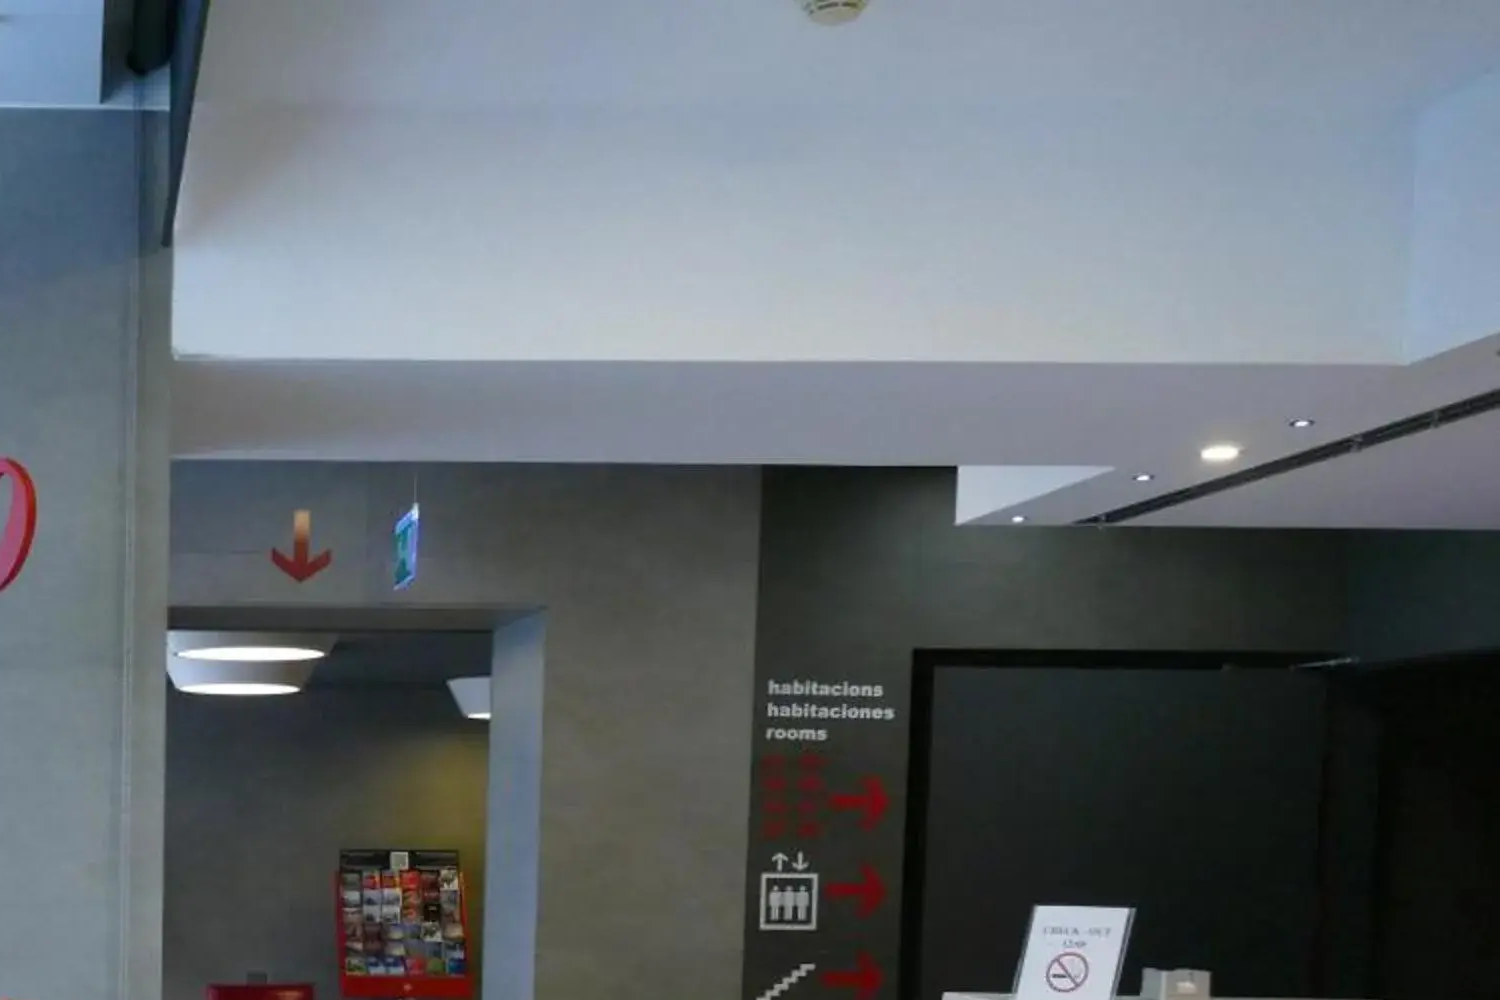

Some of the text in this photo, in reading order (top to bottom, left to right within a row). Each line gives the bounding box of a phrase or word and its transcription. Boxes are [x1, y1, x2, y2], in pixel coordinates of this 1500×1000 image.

[767, 679, 884, 697] habitacions
[767, 702, 896, 720] habitaciones
[765, 727, 828, 741] rooms
